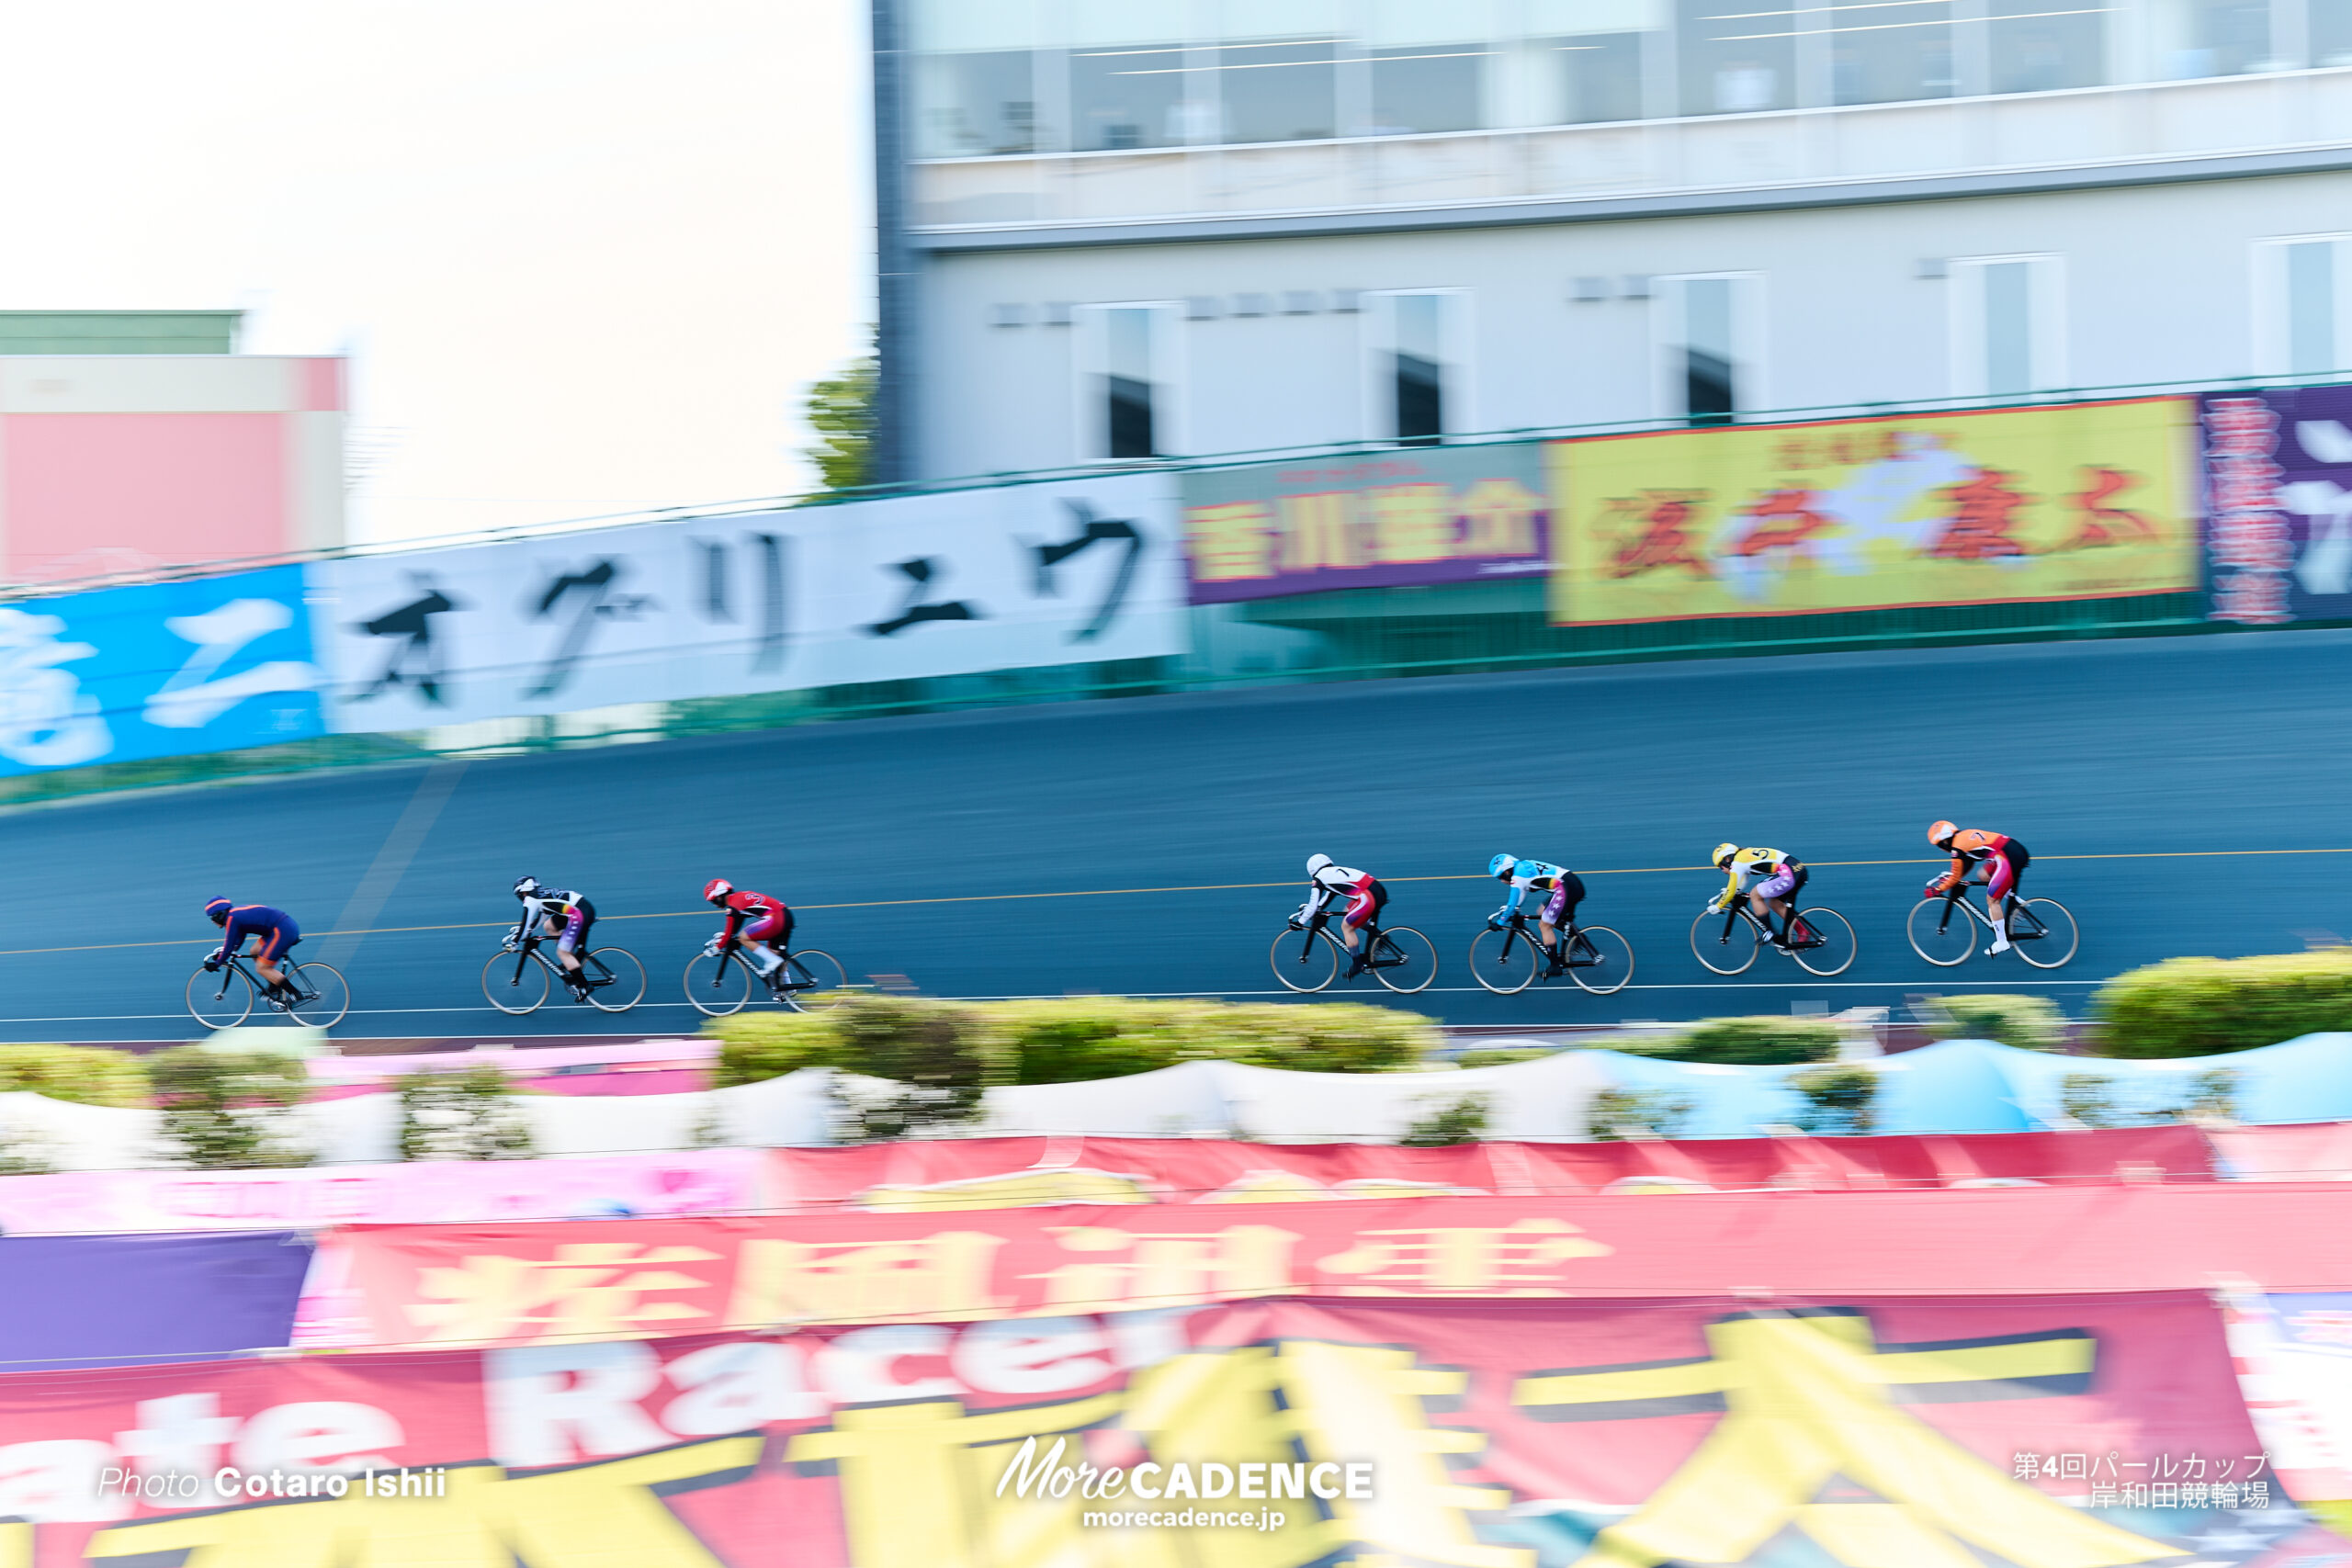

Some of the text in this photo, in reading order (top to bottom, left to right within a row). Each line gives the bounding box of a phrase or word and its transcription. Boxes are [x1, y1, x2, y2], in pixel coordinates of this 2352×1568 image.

[1752, 849, 1770, 860] 5
[745, 893, 764, 906] 3
[484, 1302, 1209, 1468] Racer
